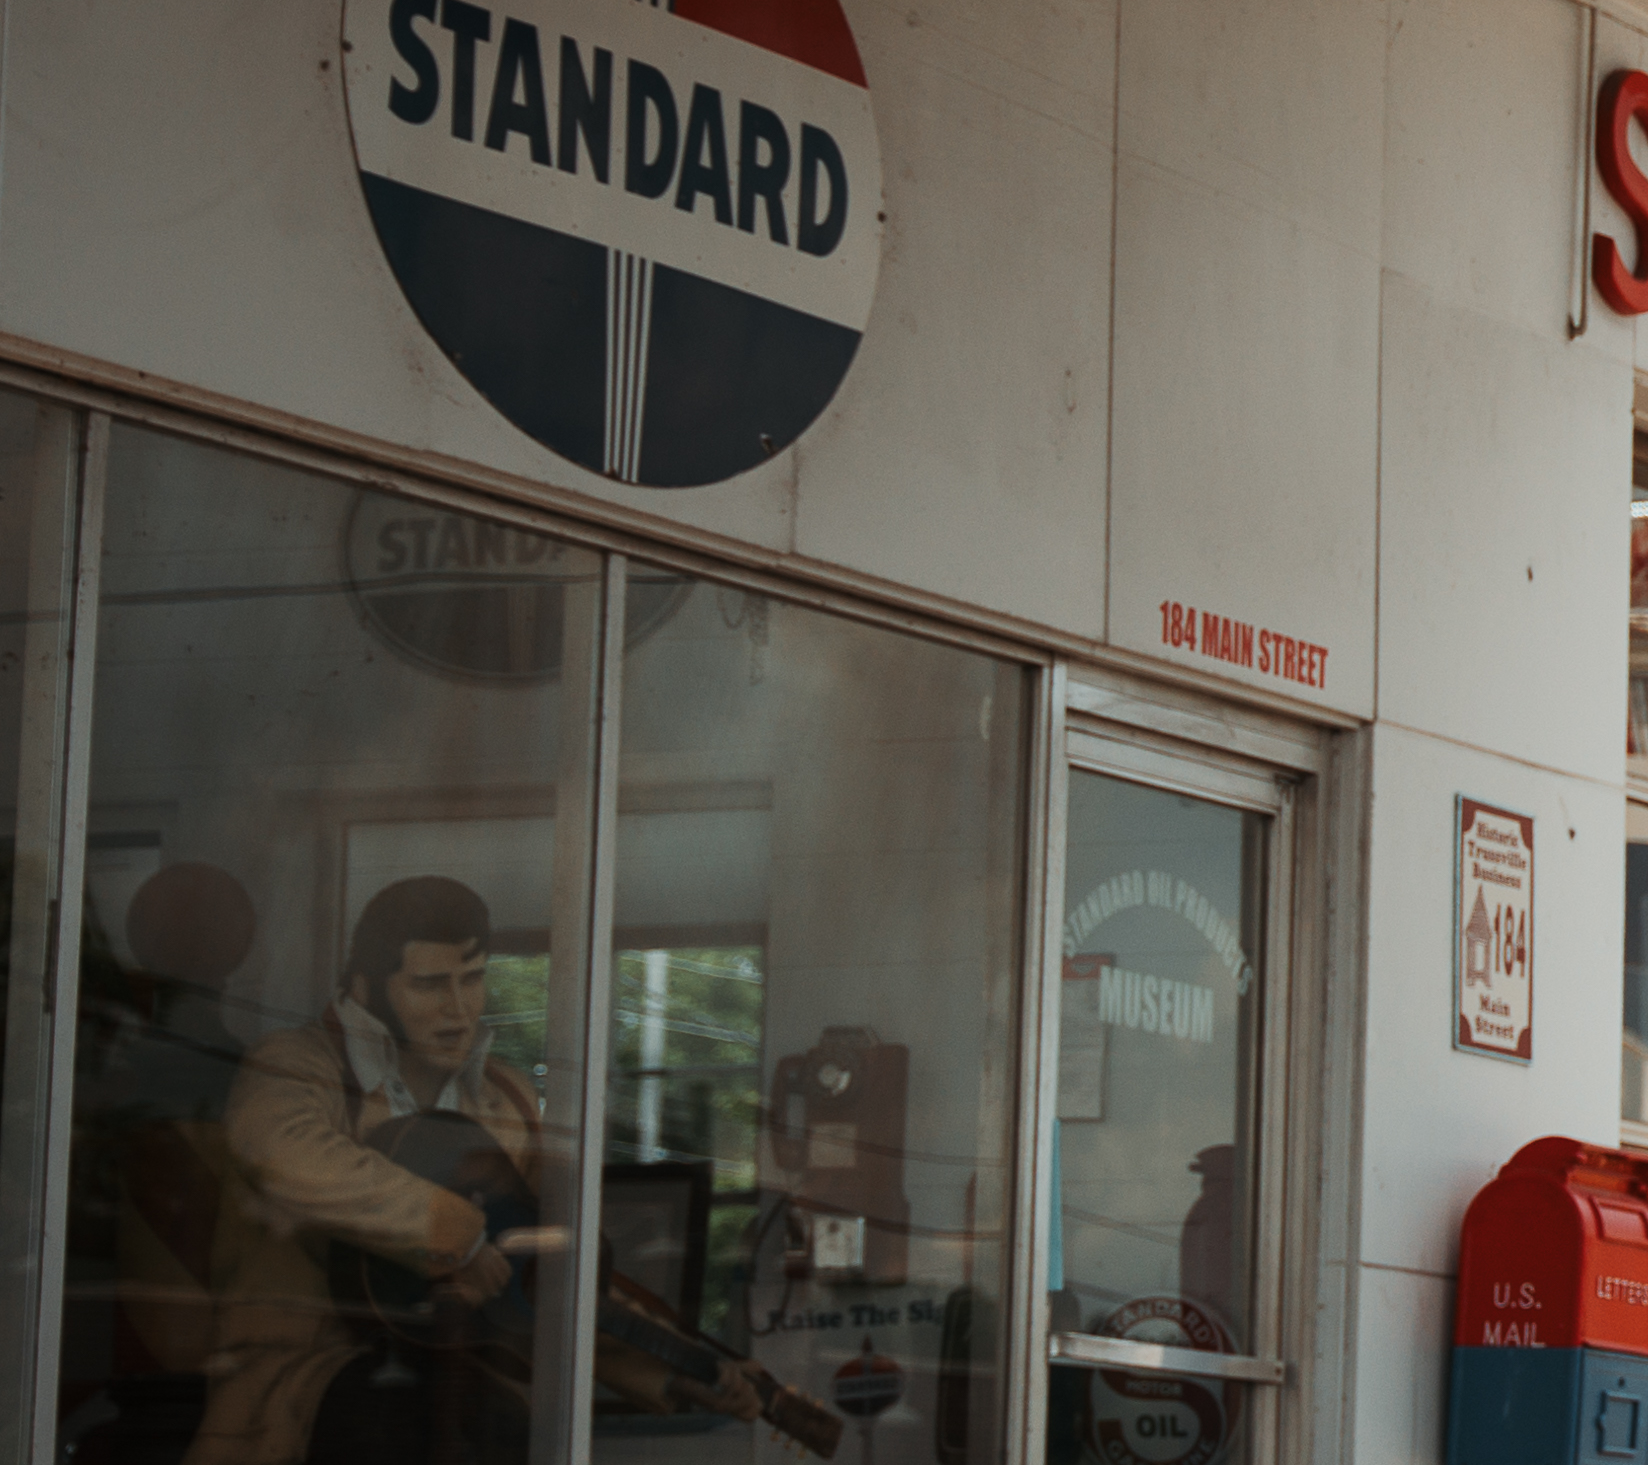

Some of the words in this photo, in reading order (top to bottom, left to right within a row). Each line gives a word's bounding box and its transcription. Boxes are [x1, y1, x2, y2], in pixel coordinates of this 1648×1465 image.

[377, 518, 567, 571] STAND
[1159, 600, 1197, 651] 184
[1201, 611, 1254, 668] MAIN
[1258, 628, 1329, 689] STREET
[1064, 869, 1145, 958] STANDARD
[1147, 870, 1174, 908] OIL
[1174, 879, 1254, 997] PRODUCTS
[1493, 903, 1526, 977] 184
[1099, 965, 1215, 1044] MUSEUM
[1478, 993, 1511, 1017] Main
[1475, 1015, 1514, 1040] Street
[1493, 1282, 1542, 1308] U.S.
[849, 1303, 900, 1327] The
[1106, 1301, 1215, 1343] TANDARD
[1482, 1321, 1546, 1348] MAIL
[1125, 1380, 1184, 1396] MOTOR
[1136, 1414, 1188, 1438] OIL
